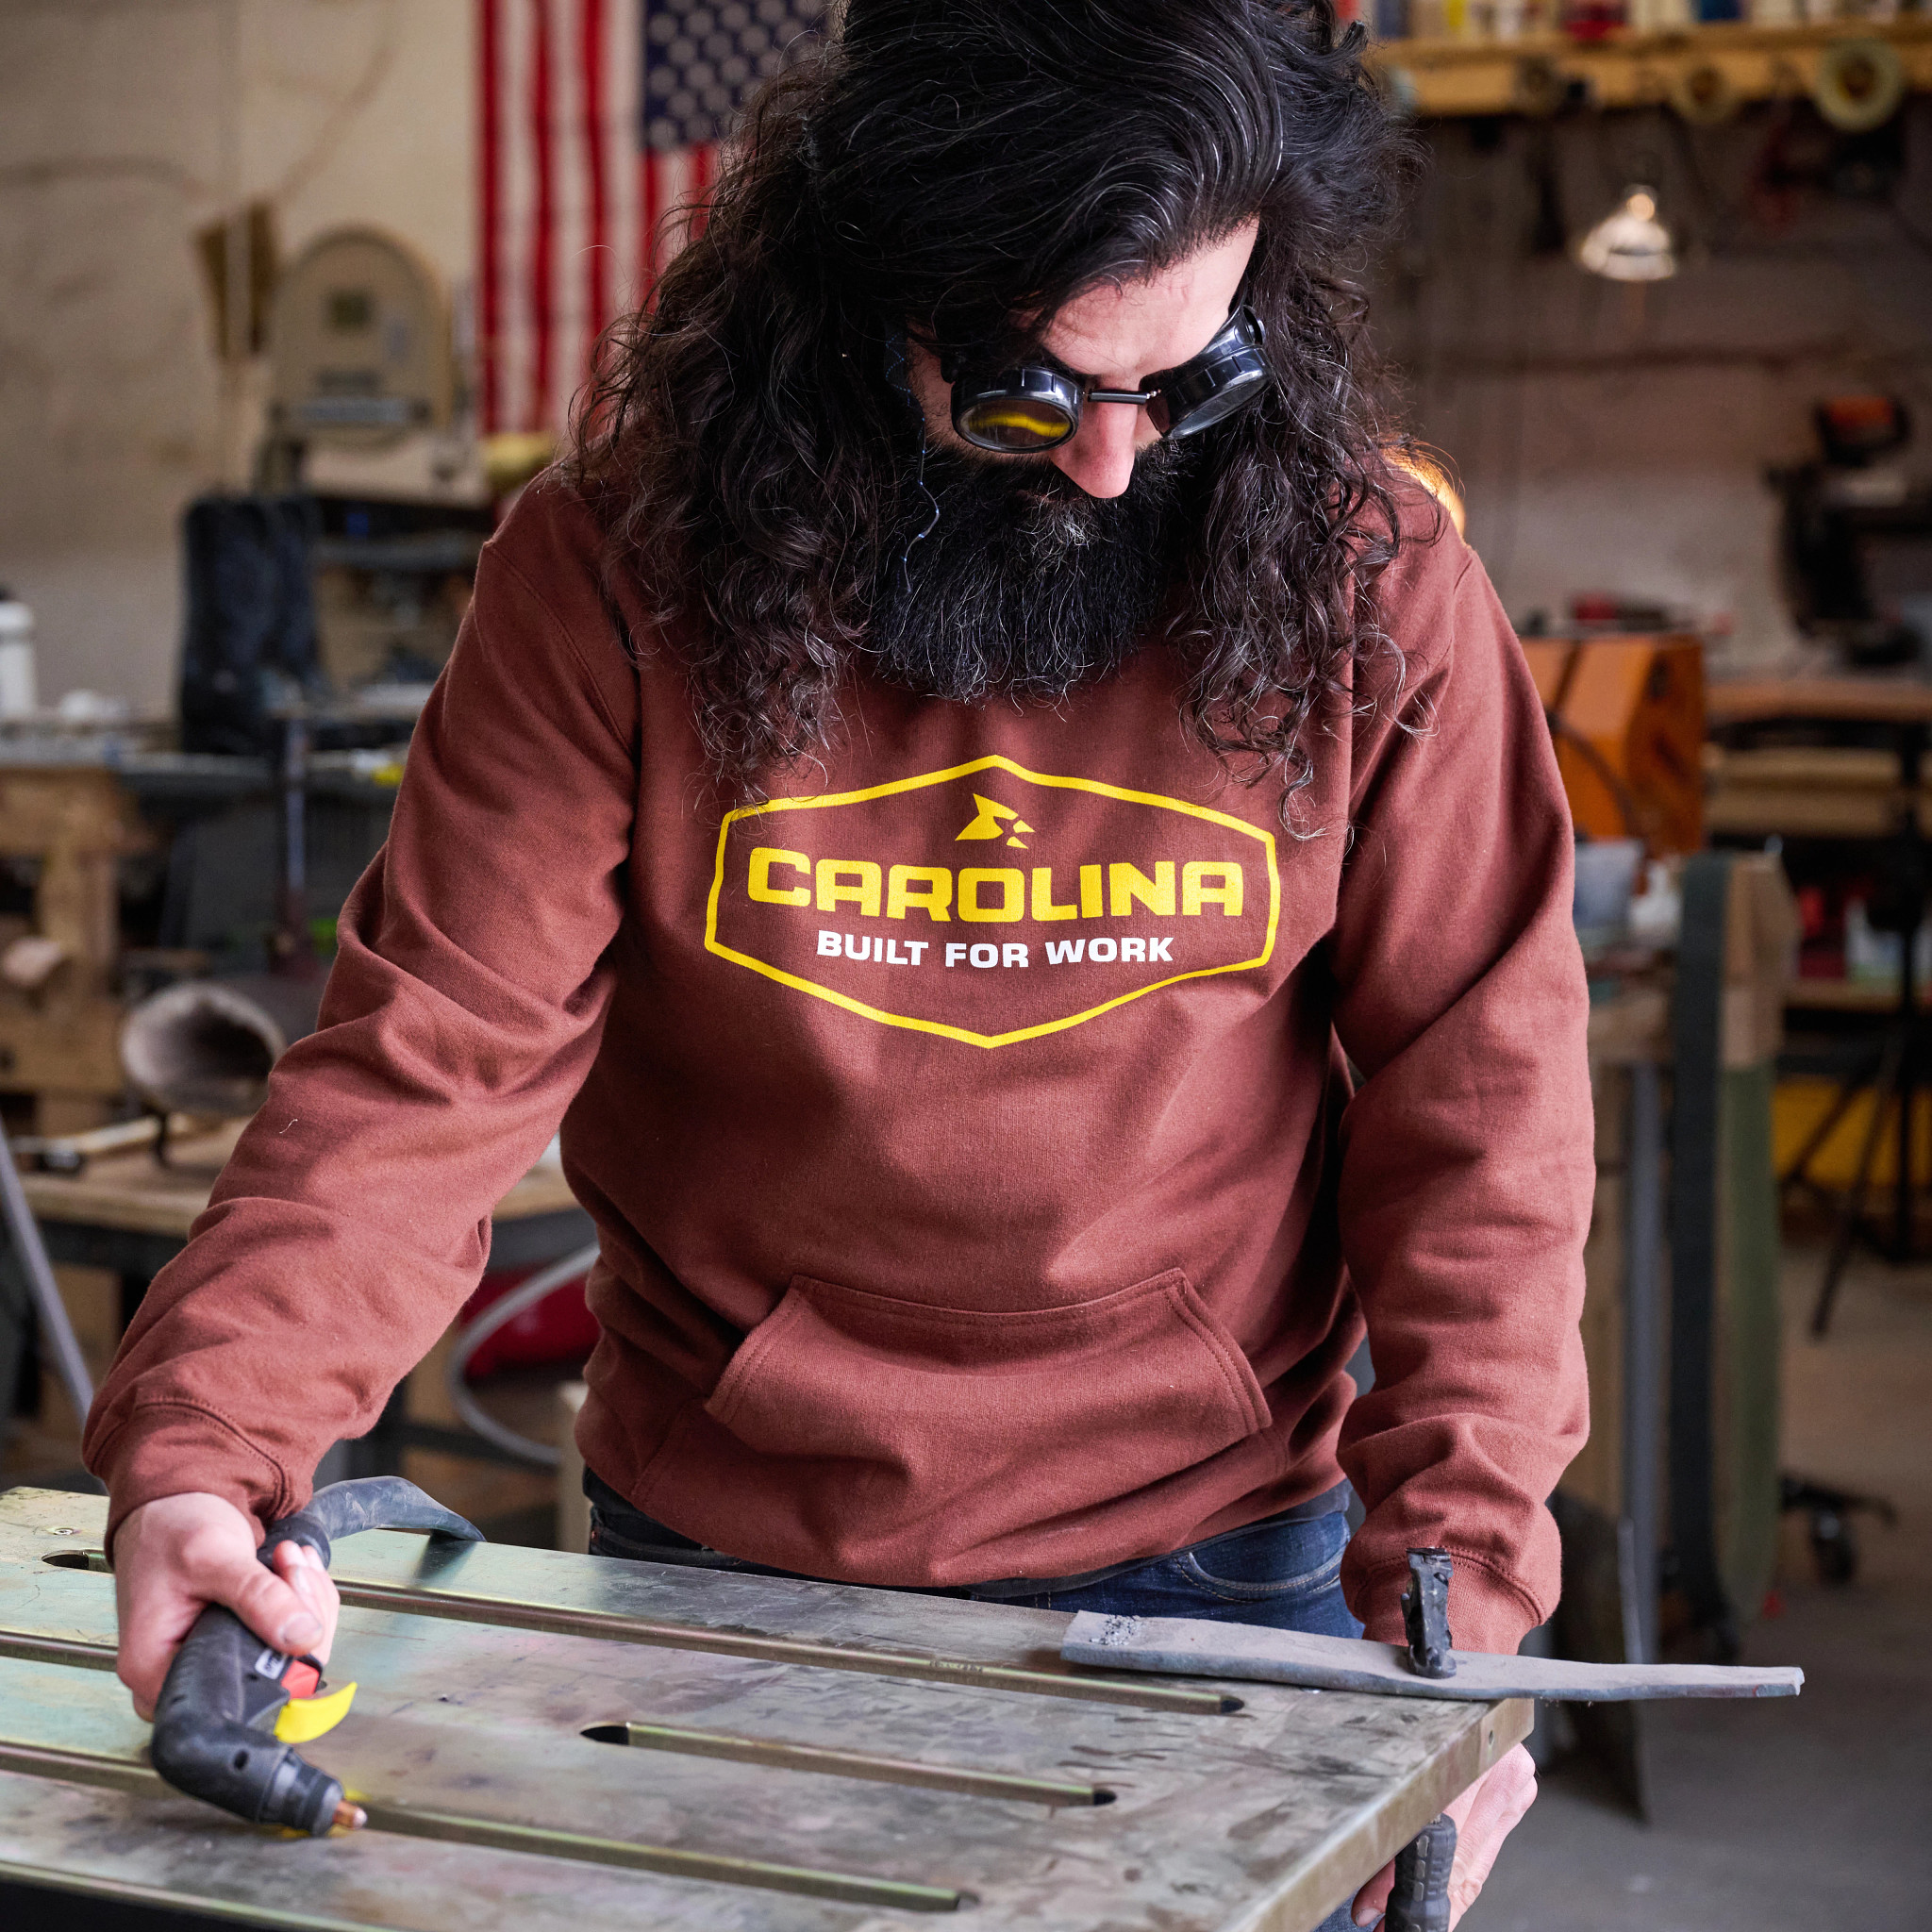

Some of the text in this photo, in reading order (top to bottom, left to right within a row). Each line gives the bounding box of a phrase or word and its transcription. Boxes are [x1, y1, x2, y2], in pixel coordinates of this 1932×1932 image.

[747, 847, 1244, 923] CAROLINA
[816, 929, 1174, 968] BUILT FOR WORK
